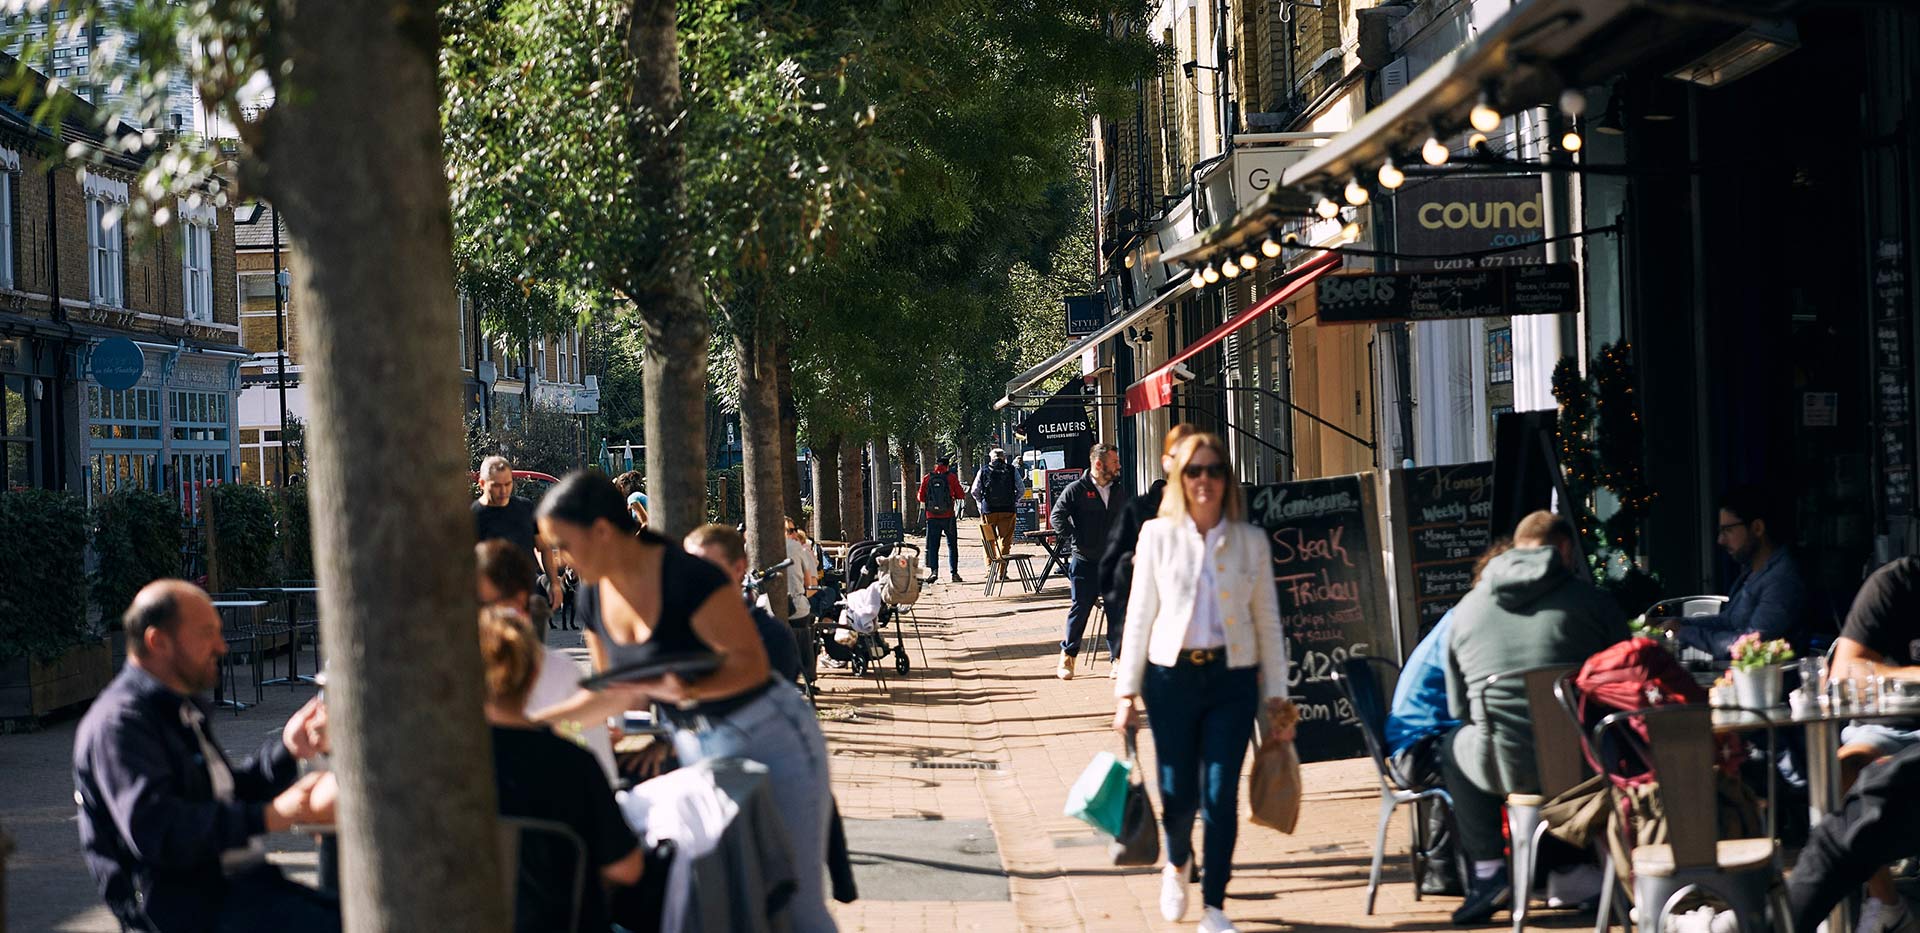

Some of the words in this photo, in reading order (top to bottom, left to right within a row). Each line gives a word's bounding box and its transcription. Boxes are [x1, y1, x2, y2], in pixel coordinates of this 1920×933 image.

[1418, 193, 1542, 230] cound
[1318, 275, 1396, 304] Beers
[1072, 319, 1100, 327] STYLE
[1038, 421, 1086, 434] CLEAVERS
[1273, 526, 1355, 568] Steak
